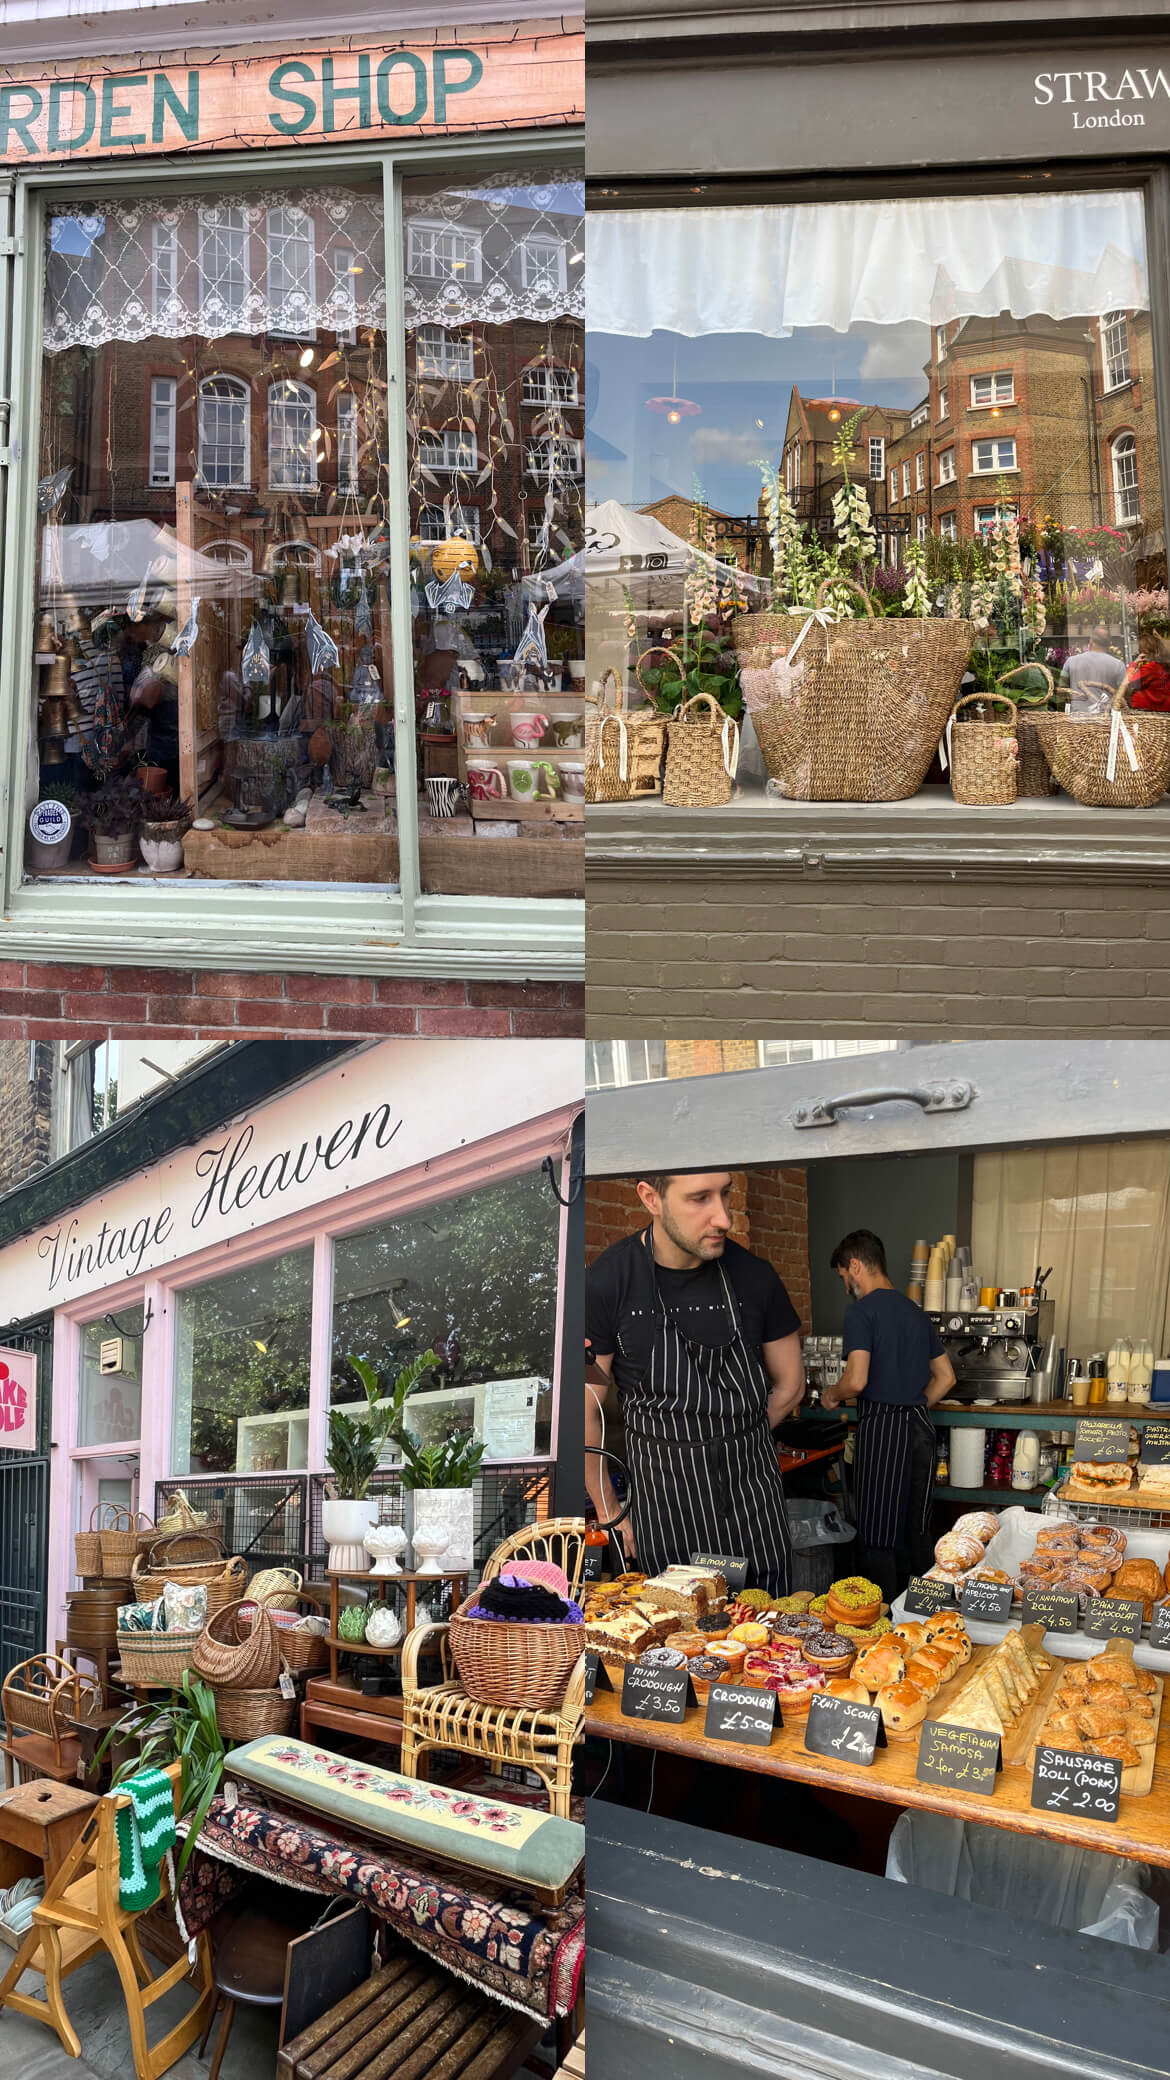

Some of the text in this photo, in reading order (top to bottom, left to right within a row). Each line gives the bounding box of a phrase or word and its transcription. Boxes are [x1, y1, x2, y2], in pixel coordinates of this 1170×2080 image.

[1034, 68, 1170, 105] STRAW
[0, 49, 484, 155] RDEN SHOP
[1072, 109, 1146, 128] London
[39, 816, 62, 824] GUILD
[37, 1103, 403, 1292] Vintage Heaven
[911, 1578, 945, 1591] ALMOND
[967, 1600, 1001, 1612] £4.50
[1026, 1591, 1076, 1604] CINNAMON
[1031, 1602, 1054, 1611] ROLL
[1118, 1602, 1131, 1612] AU
[1033, 1614, 1072, 1627] £4.50
[1090, 1608, 1139, 1620] CHOCOLAT
[632, 1667, 660, 1678] MINI
[627, 1676, 684, 1693] CRODOUGH
[634, 1693, 680, 1713] £3.50
[712, 1688, 775, 1710] CRODOUGH
[720, 1711, 772, 1731] £5.00
[843, 1705, 879, 1721] SCONE
[831, 1726, 874, 1754] £2.50
[929, 1728, 999, 1750] VEGETARIAN
[928, 1740, 984, 1760] SAMOSA
[923, 1754, 935, 1767] 2
[935, 1757, 954, 1776] for
[1040, 1750, 1115, 1774] SAUSAGE
[1038, 1765, 1118, 1795] ROLL (PORK)
